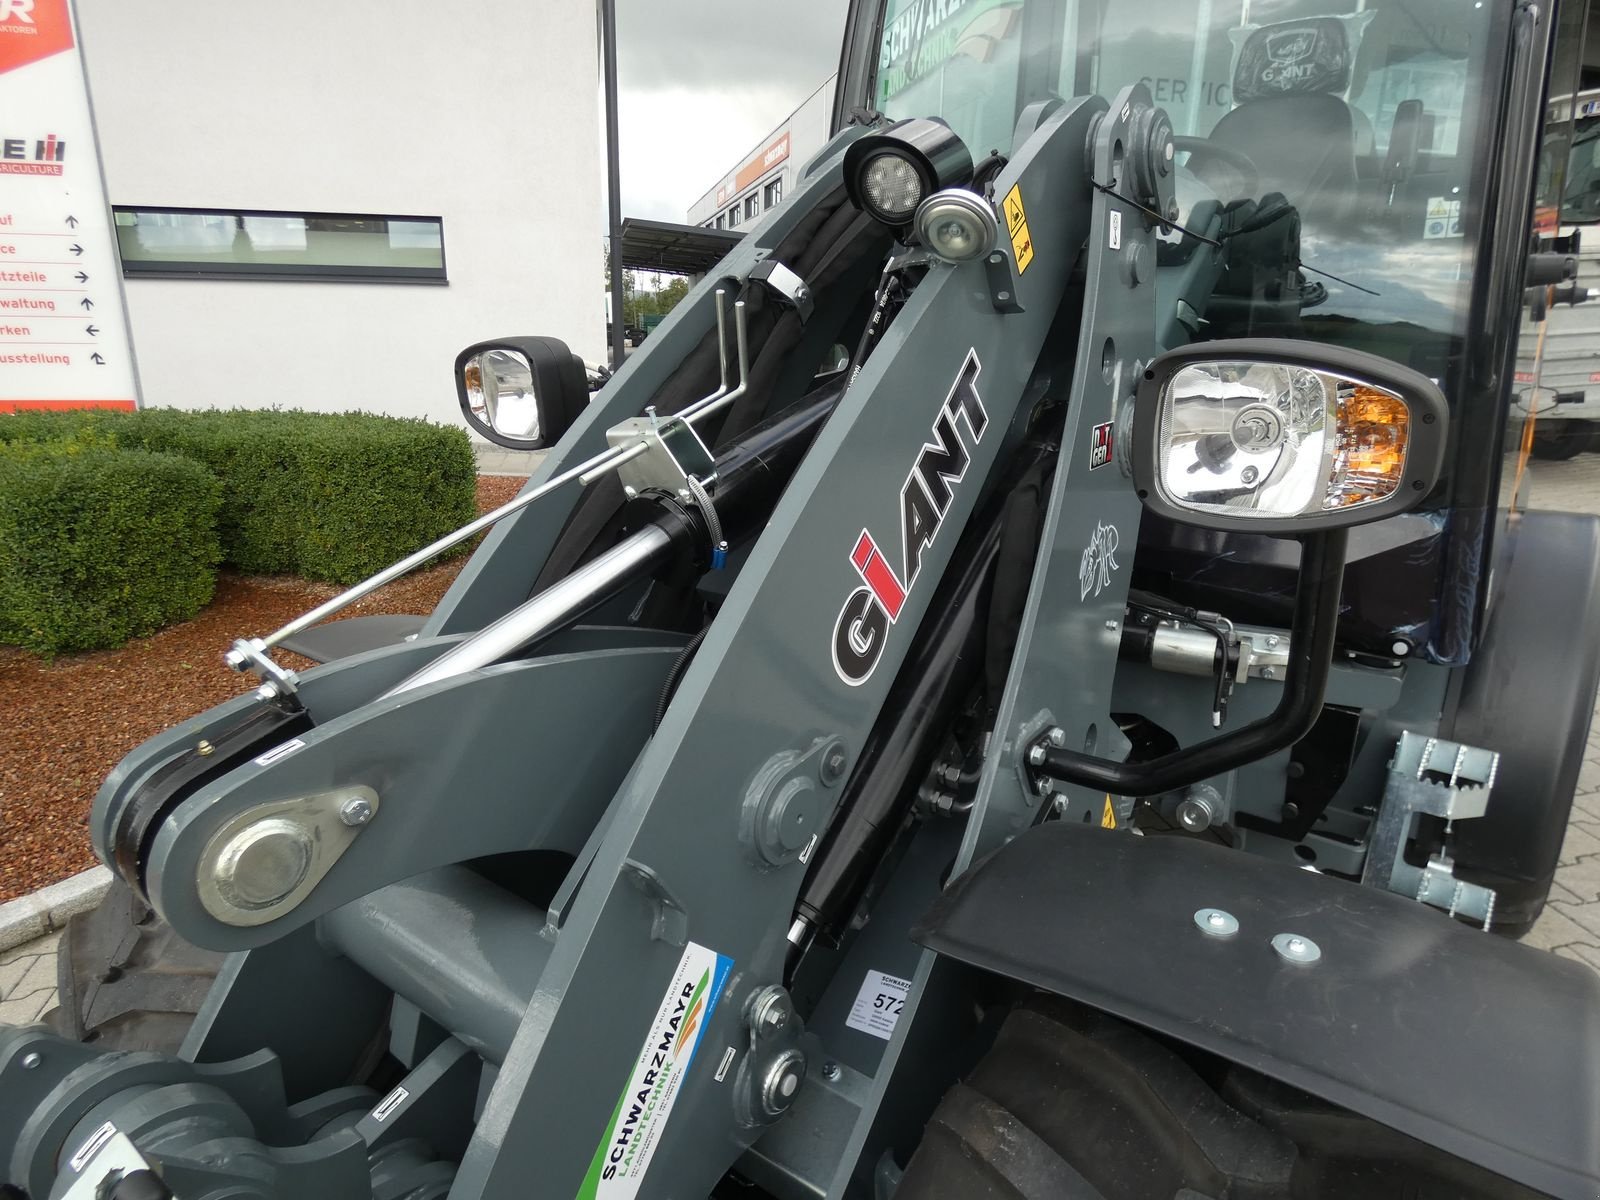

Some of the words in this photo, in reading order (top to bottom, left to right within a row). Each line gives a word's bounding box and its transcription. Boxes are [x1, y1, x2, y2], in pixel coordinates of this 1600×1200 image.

[1262, 63, 1315, 82] GANT
[1140, 76, 1230, 106] ERIC
[0, 163, 61, 175] RICULTURE
[0, 245, 16, 254] ce
[0, 271, 47, 282] tzteile
[873, 993, 905, 1015] 572
[602, 981, 696, 1181] SCHWARZMAYR
[617, 1060, 675, 1178] LANDTECHNIK
